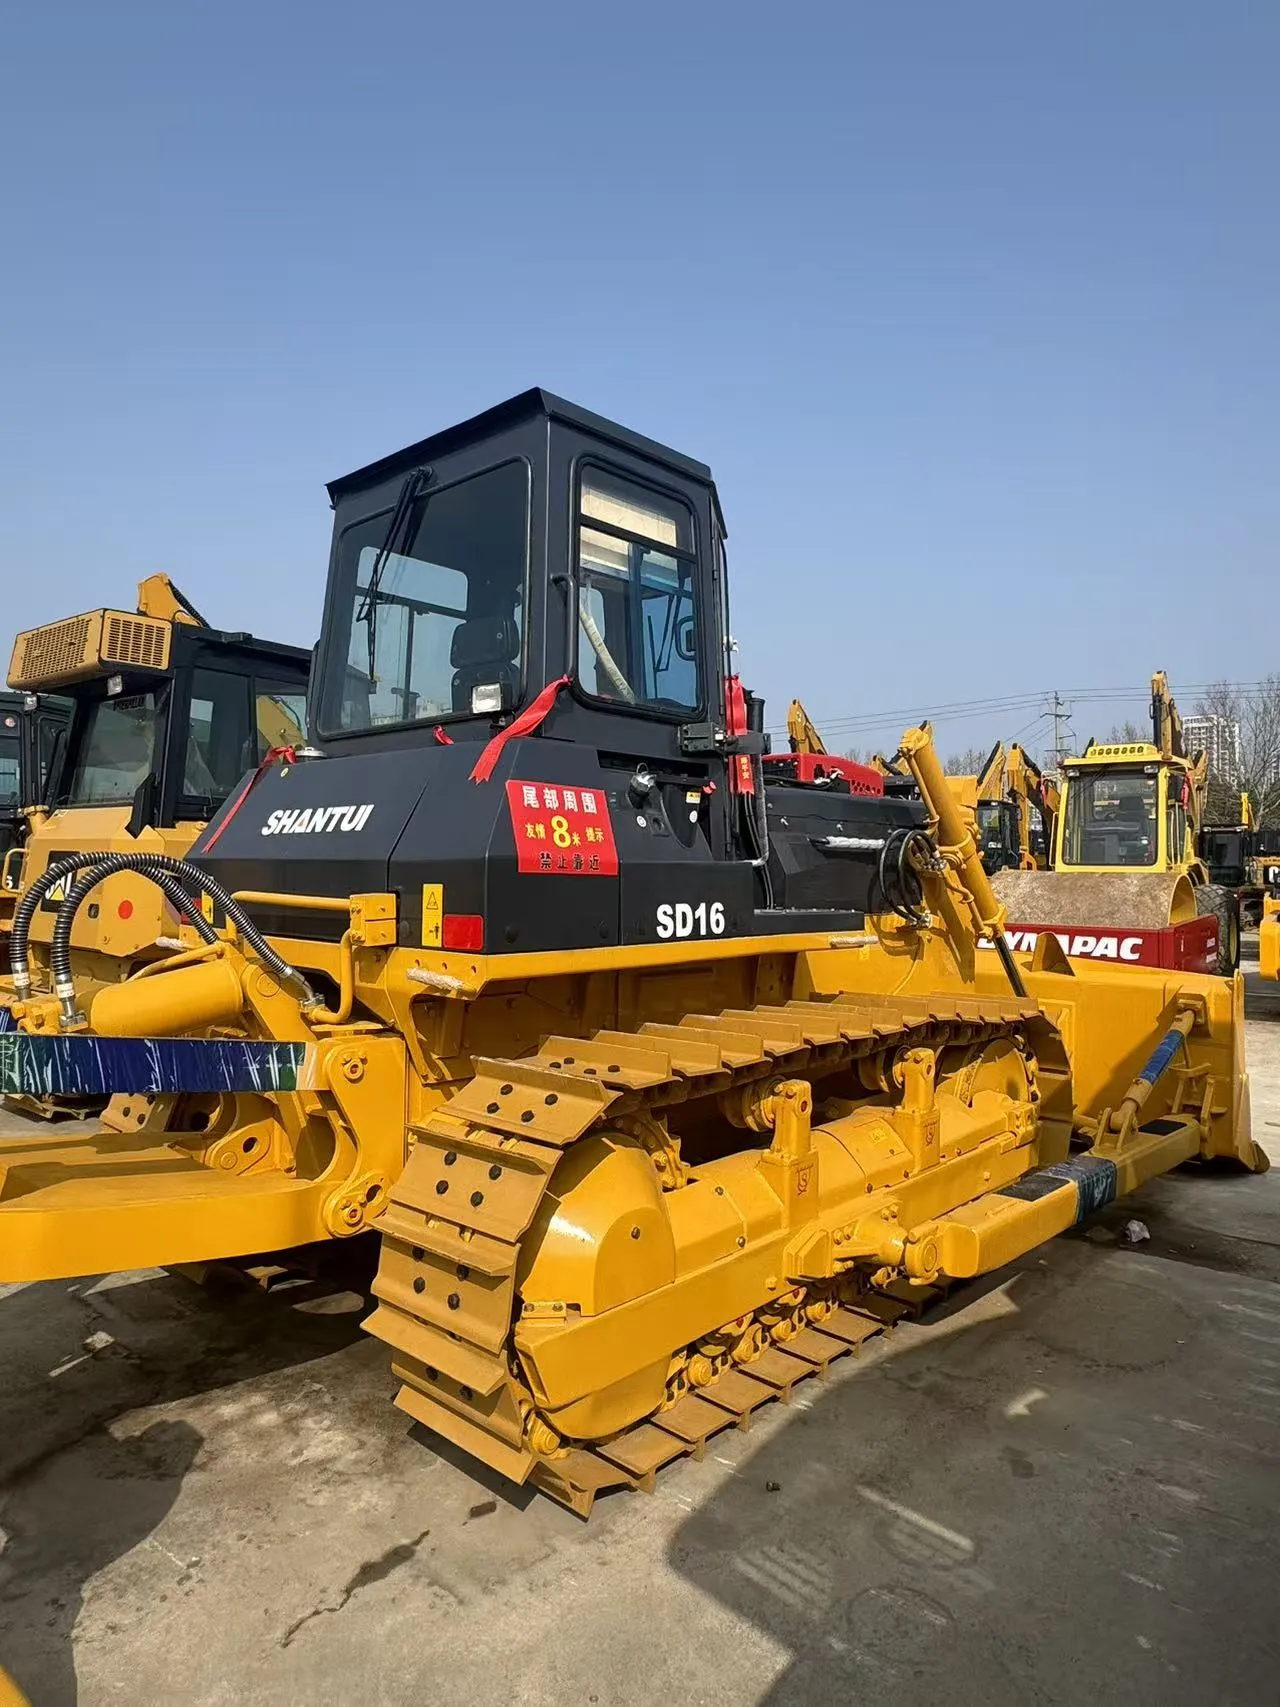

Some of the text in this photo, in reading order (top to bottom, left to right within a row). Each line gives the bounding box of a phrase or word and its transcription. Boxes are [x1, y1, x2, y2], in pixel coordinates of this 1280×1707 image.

[522, 785, 598, 814] 尾部周围
[261, 804, 375, 836] SHANTUI
[525, 822, 546, 840] 友情
[585, 826, 605, 843] 提示
[539, 852, 601, 871] 禁止靠近
[656, 902, 725, 939] SD16
